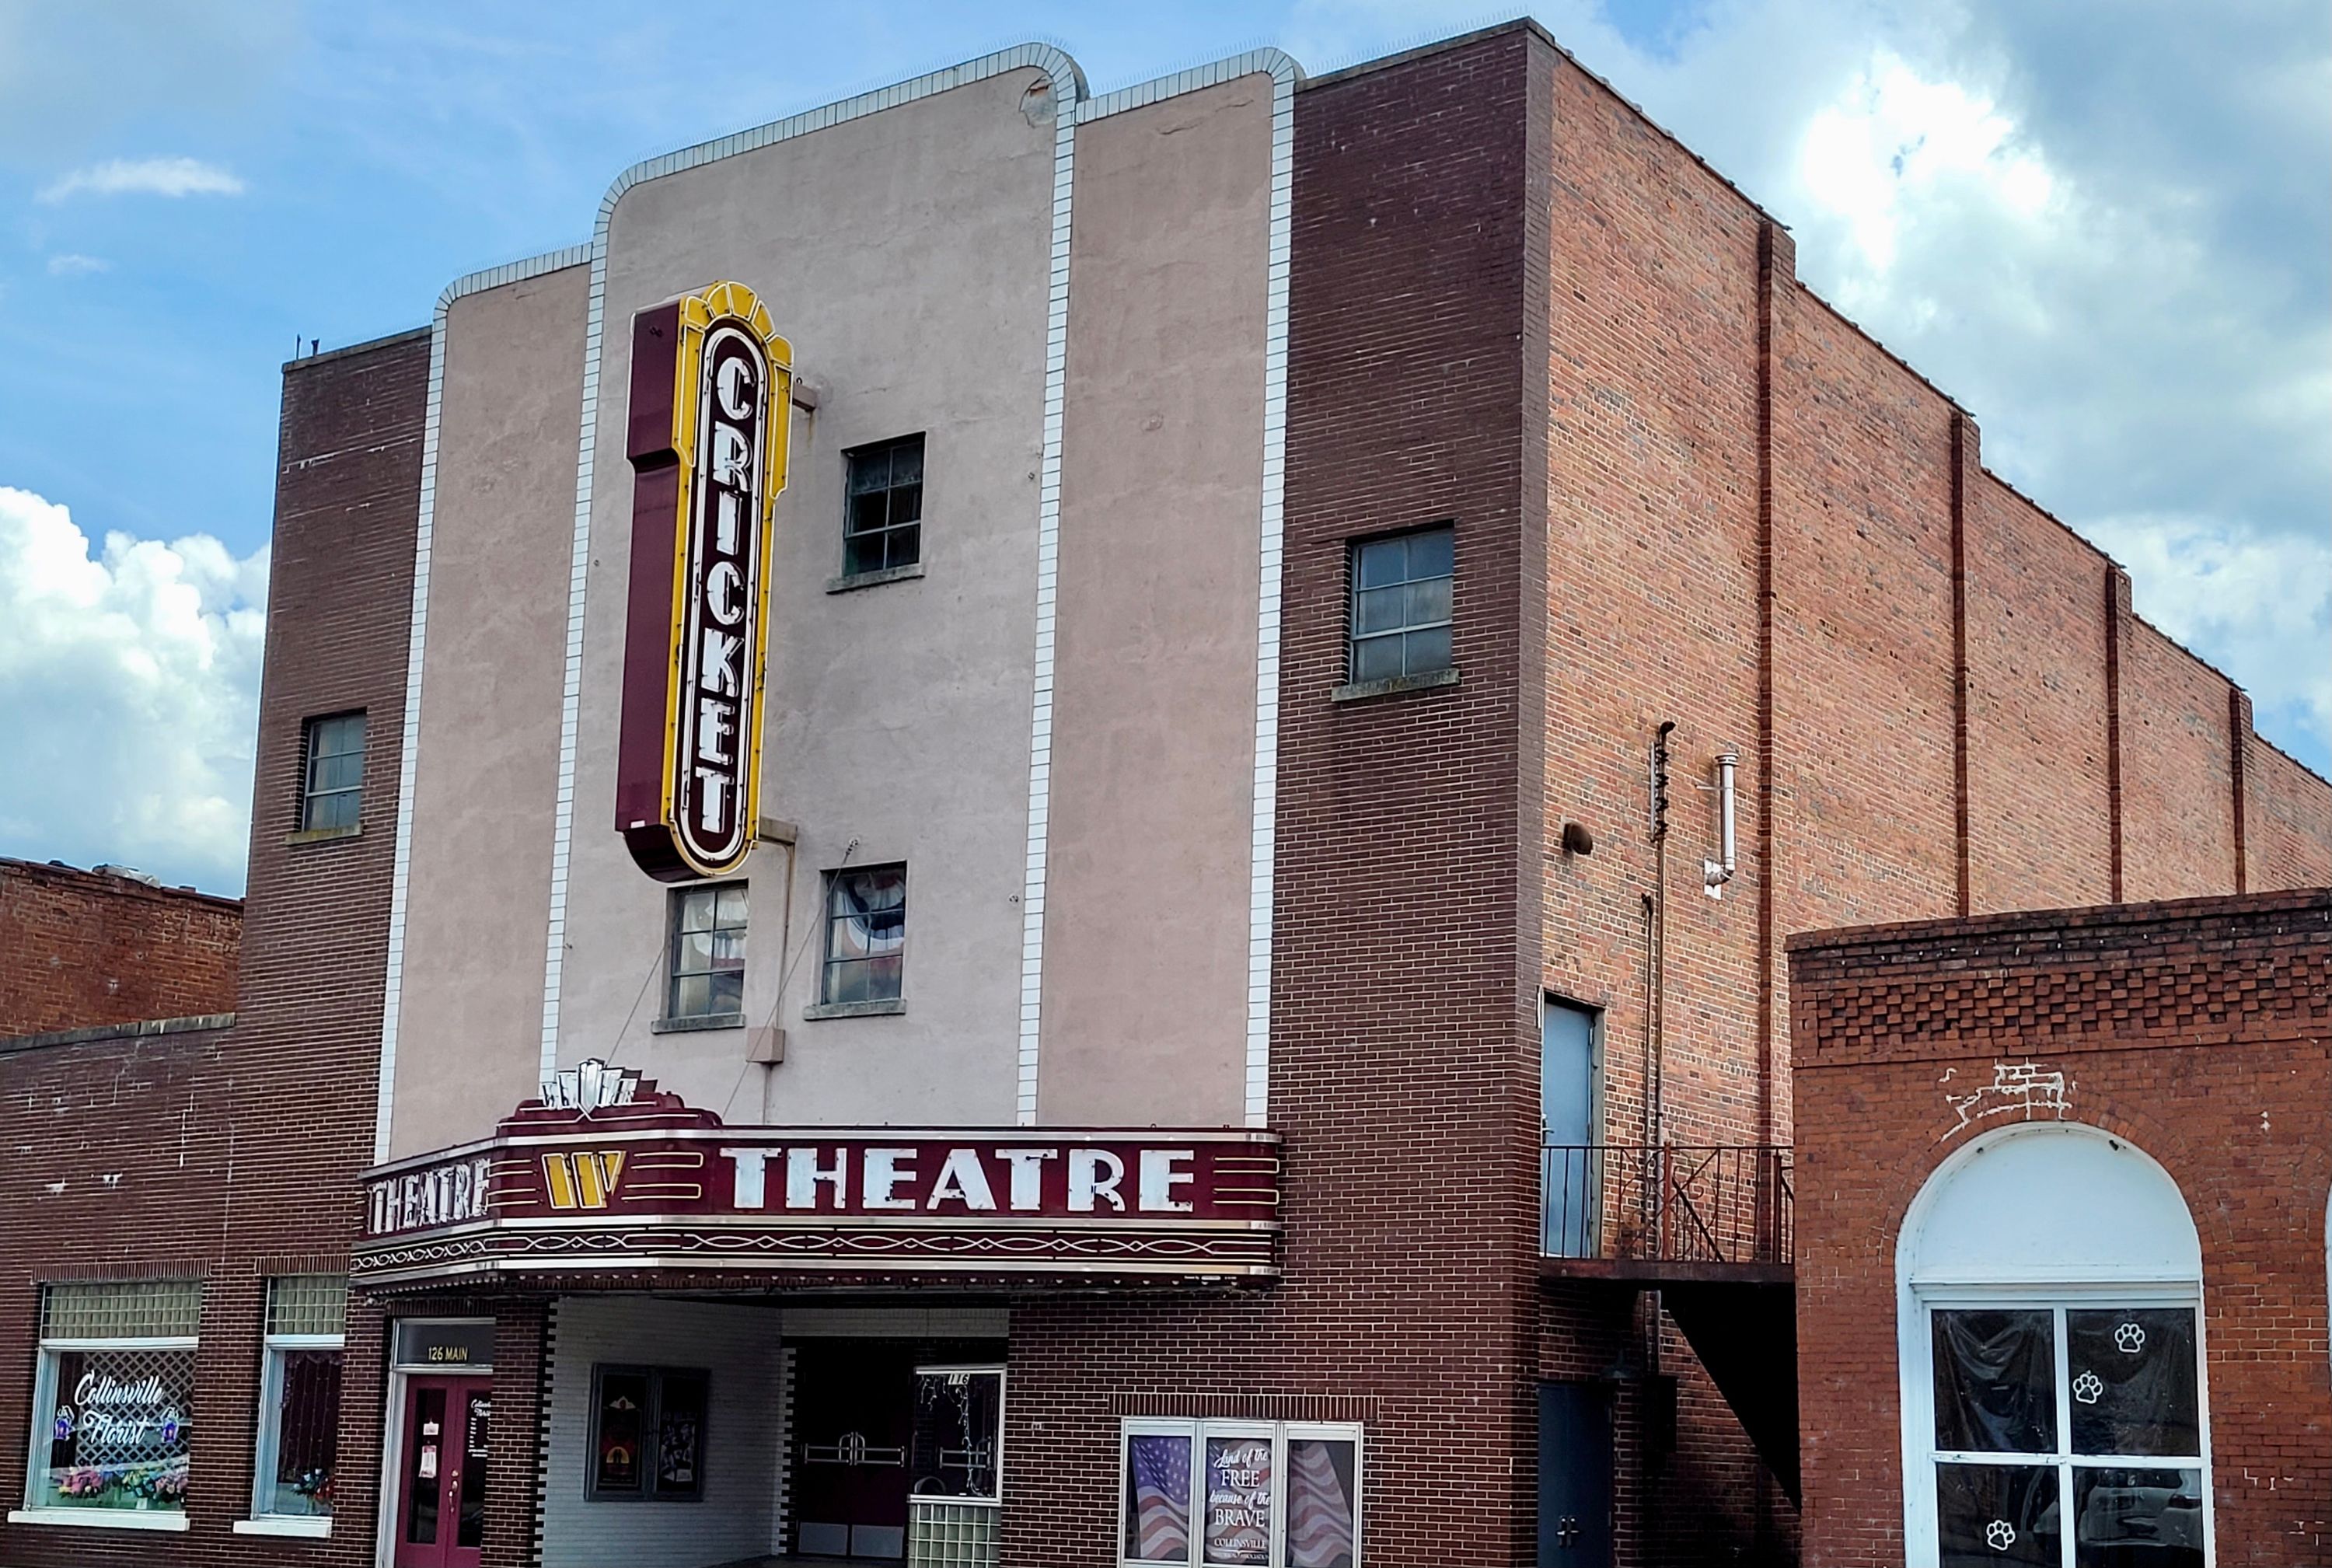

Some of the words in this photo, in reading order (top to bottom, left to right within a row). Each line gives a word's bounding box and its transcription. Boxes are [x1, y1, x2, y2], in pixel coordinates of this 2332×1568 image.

[695, 355, 755, 834] CRICKET
[720, 1147, 1195, 1213] THEATRE
[367, 1158, 490, 1234] THEATRE
[428, 1346, 444, 1360] 126
[445, 1346, 468, 1360] MAIN
[74, 1369, 164, 1406] Collinsville
[82, 1409, 151, 1444] Florist
[1213, 1448, 1240, 1468] Land
[1242, 1448, 1254, 1468] of
[1254, 1448, 1269, 1461] the
[1221, 1468, 1260, 1487] FREE
[1210, 1489, 1242, 1505] because
[1245, 1490, 1256, 1510] of
[1256, 1491, 1271, 1506] the
[1214, 1508, 1265, 1528] BRAVE
[1213, 1537, 1266, 1549] COLLINSVILLE
